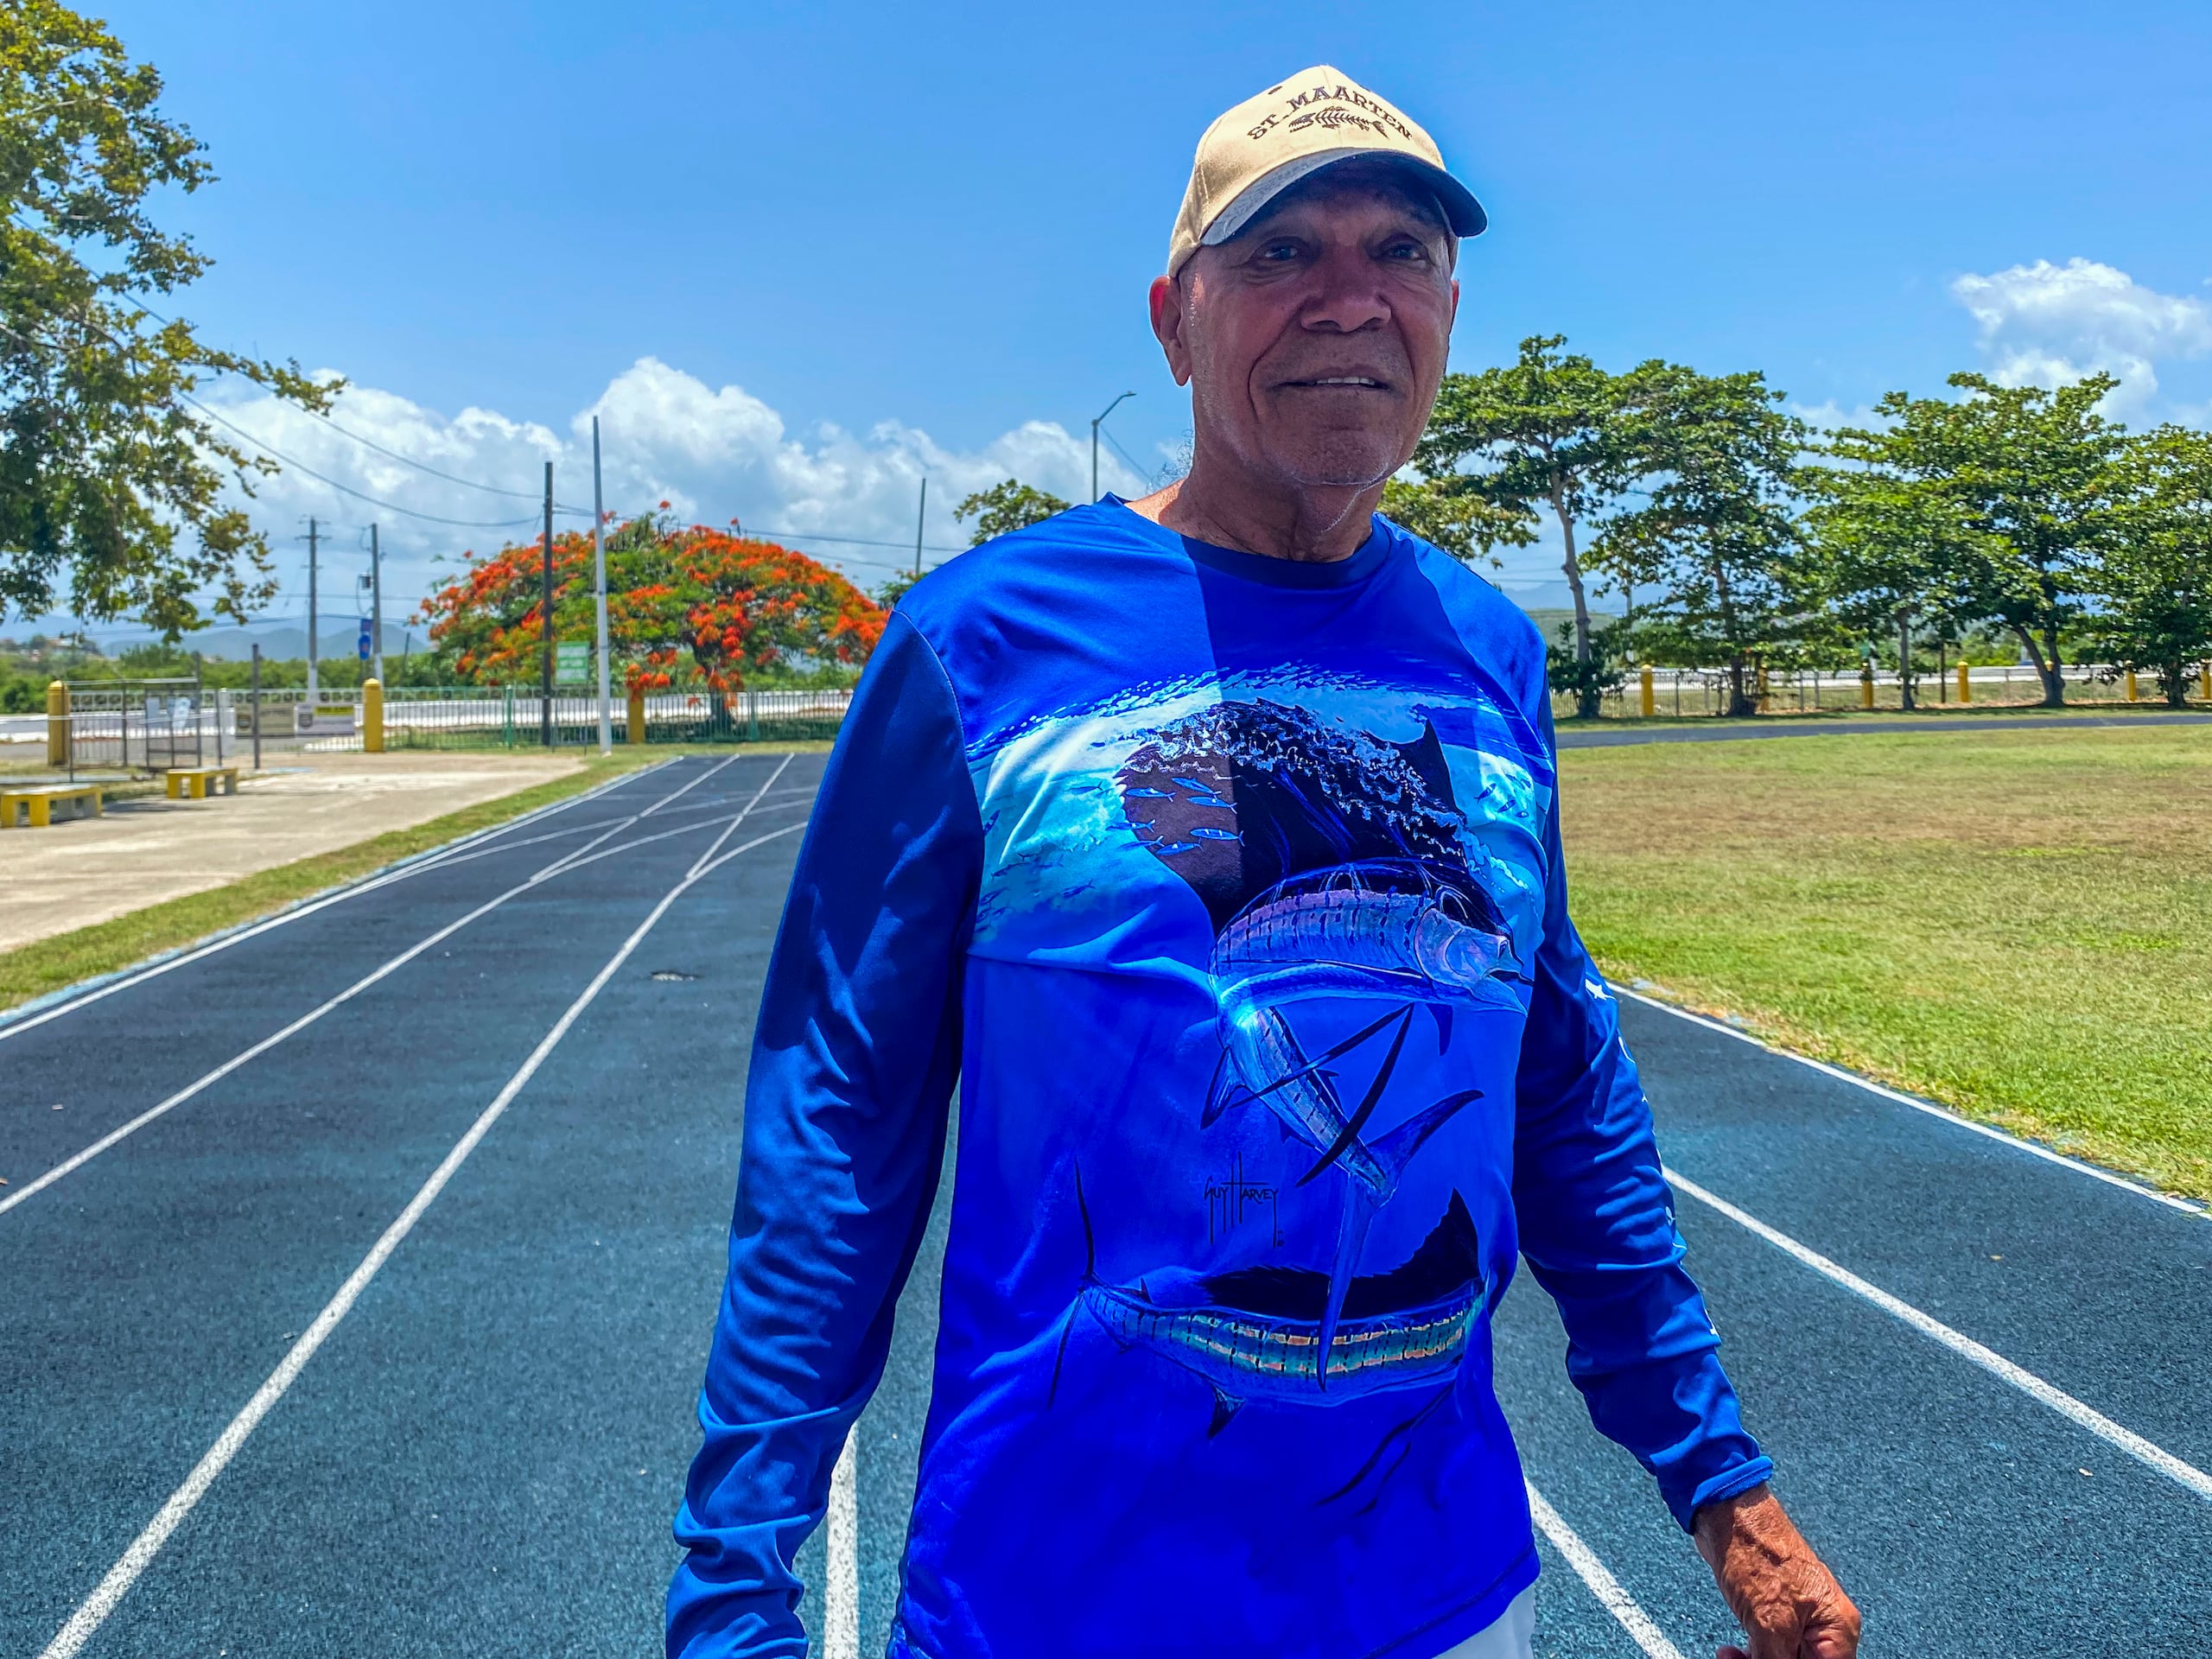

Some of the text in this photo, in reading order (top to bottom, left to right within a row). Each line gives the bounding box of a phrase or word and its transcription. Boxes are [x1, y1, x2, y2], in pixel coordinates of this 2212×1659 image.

[1287, 85, 1414, 141] MAARTEN
[1204, 1151, 1280, 1249] GUY HARVEY
